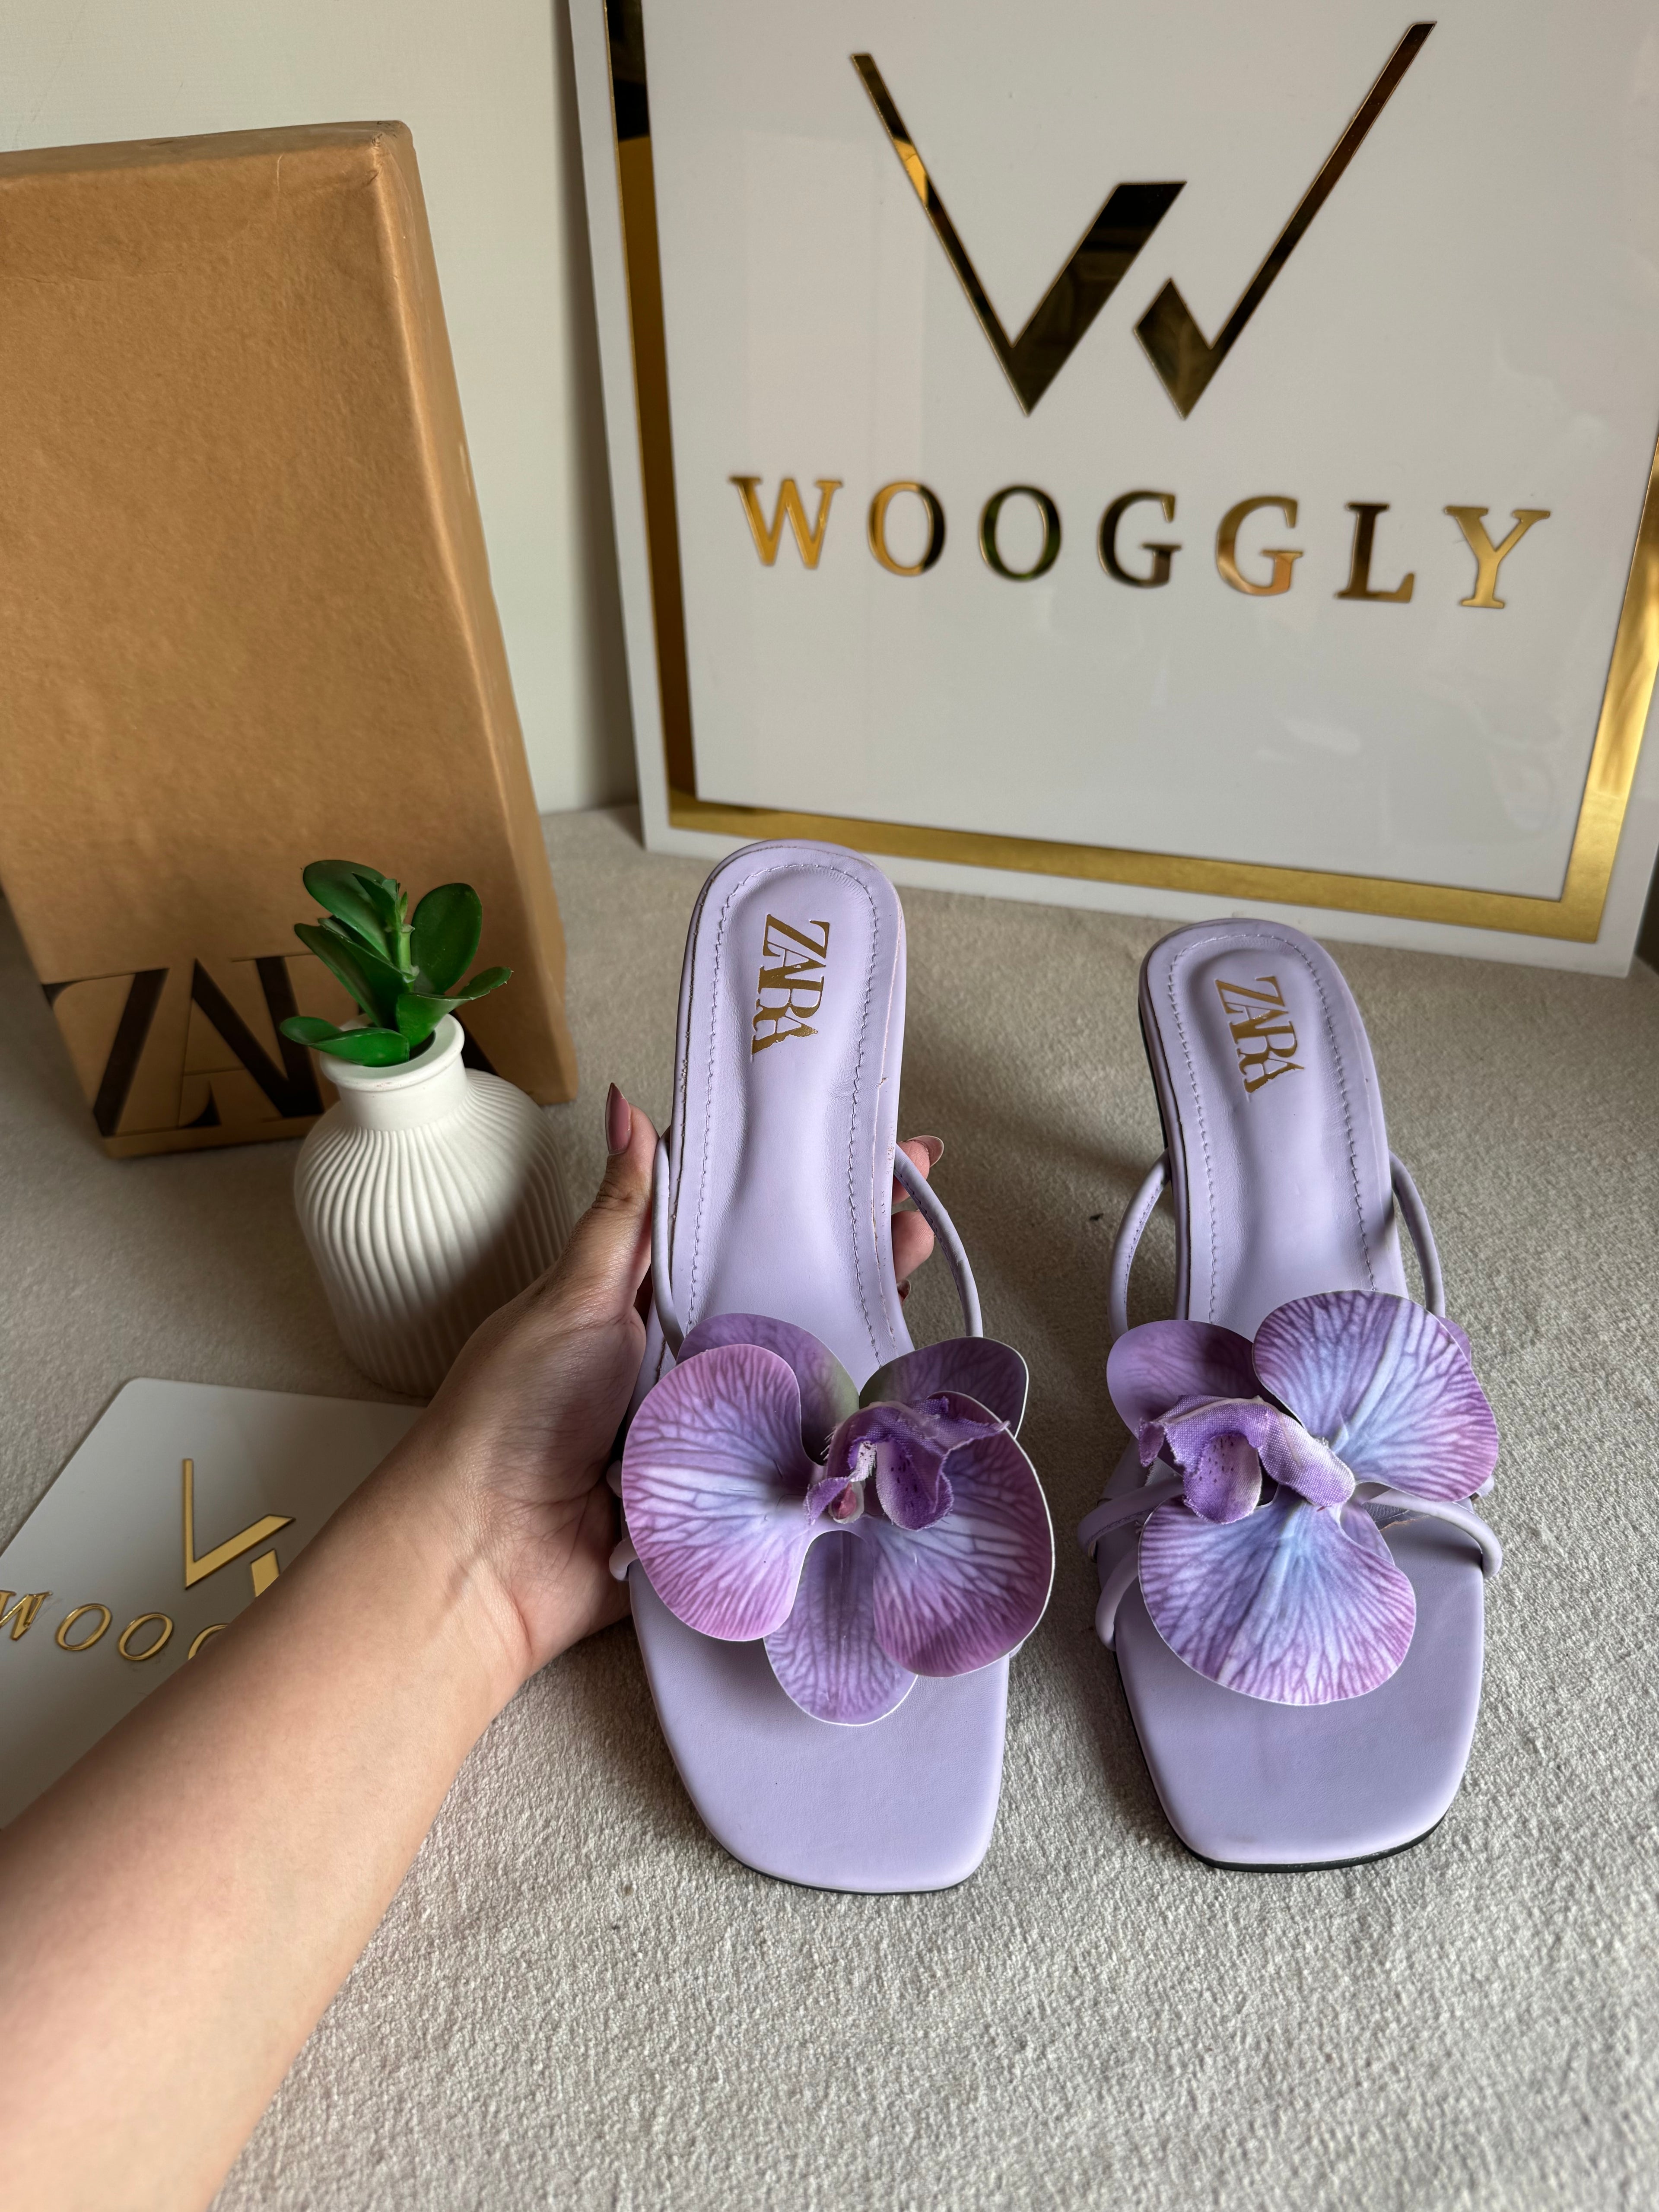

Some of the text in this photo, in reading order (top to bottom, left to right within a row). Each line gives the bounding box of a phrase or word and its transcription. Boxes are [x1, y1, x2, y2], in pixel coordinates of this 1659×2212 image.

[728, 475, 1552, 609] WOOGGLY
[41, 950, 499, 1137] ZA
[751, 914, 830, 1055] ZARA
[1214, 976, 1304, 1093] ZARA
